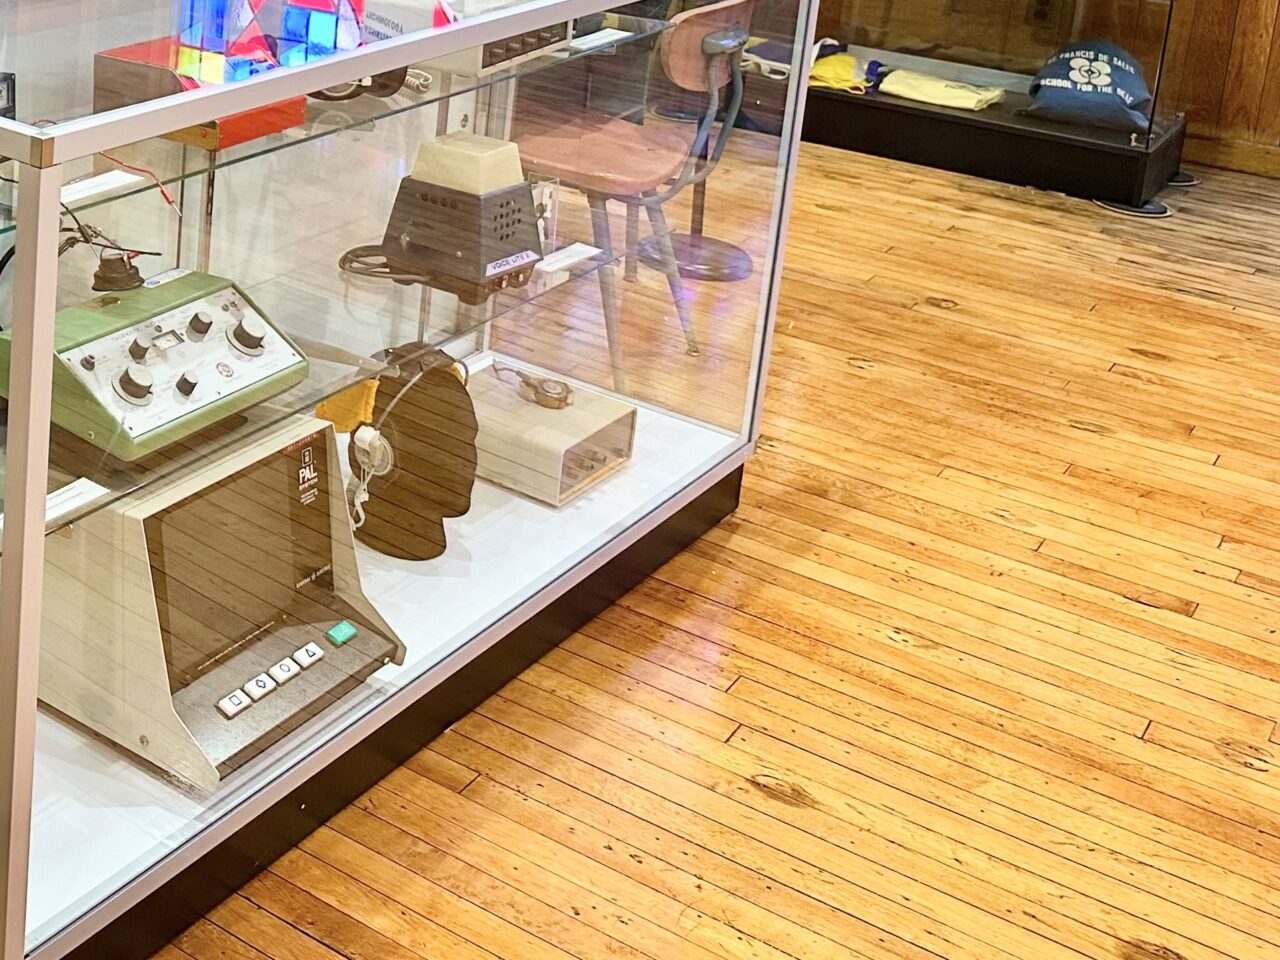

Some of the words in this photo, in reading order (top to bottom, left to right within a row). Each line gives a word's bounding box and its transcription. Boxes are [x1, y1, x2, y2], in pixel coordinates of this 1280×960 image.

[1060, 51, 1094, 59] FRANCIS
[1098, 53, 1109, 62] DE
[1113, 57, 1134, 74] SALES
[1040, 78, 1072, 88] SCHOOL
[1077, 84, 1093, 92] FOR
[1098, 86, 1113, 94] THE
[1116, 88, 1134, 104] DEAF
[491, 259, 511, 270] VOICE
[512, 254, 524, 263] LITE
[299, 464, 318, 484] PAL
